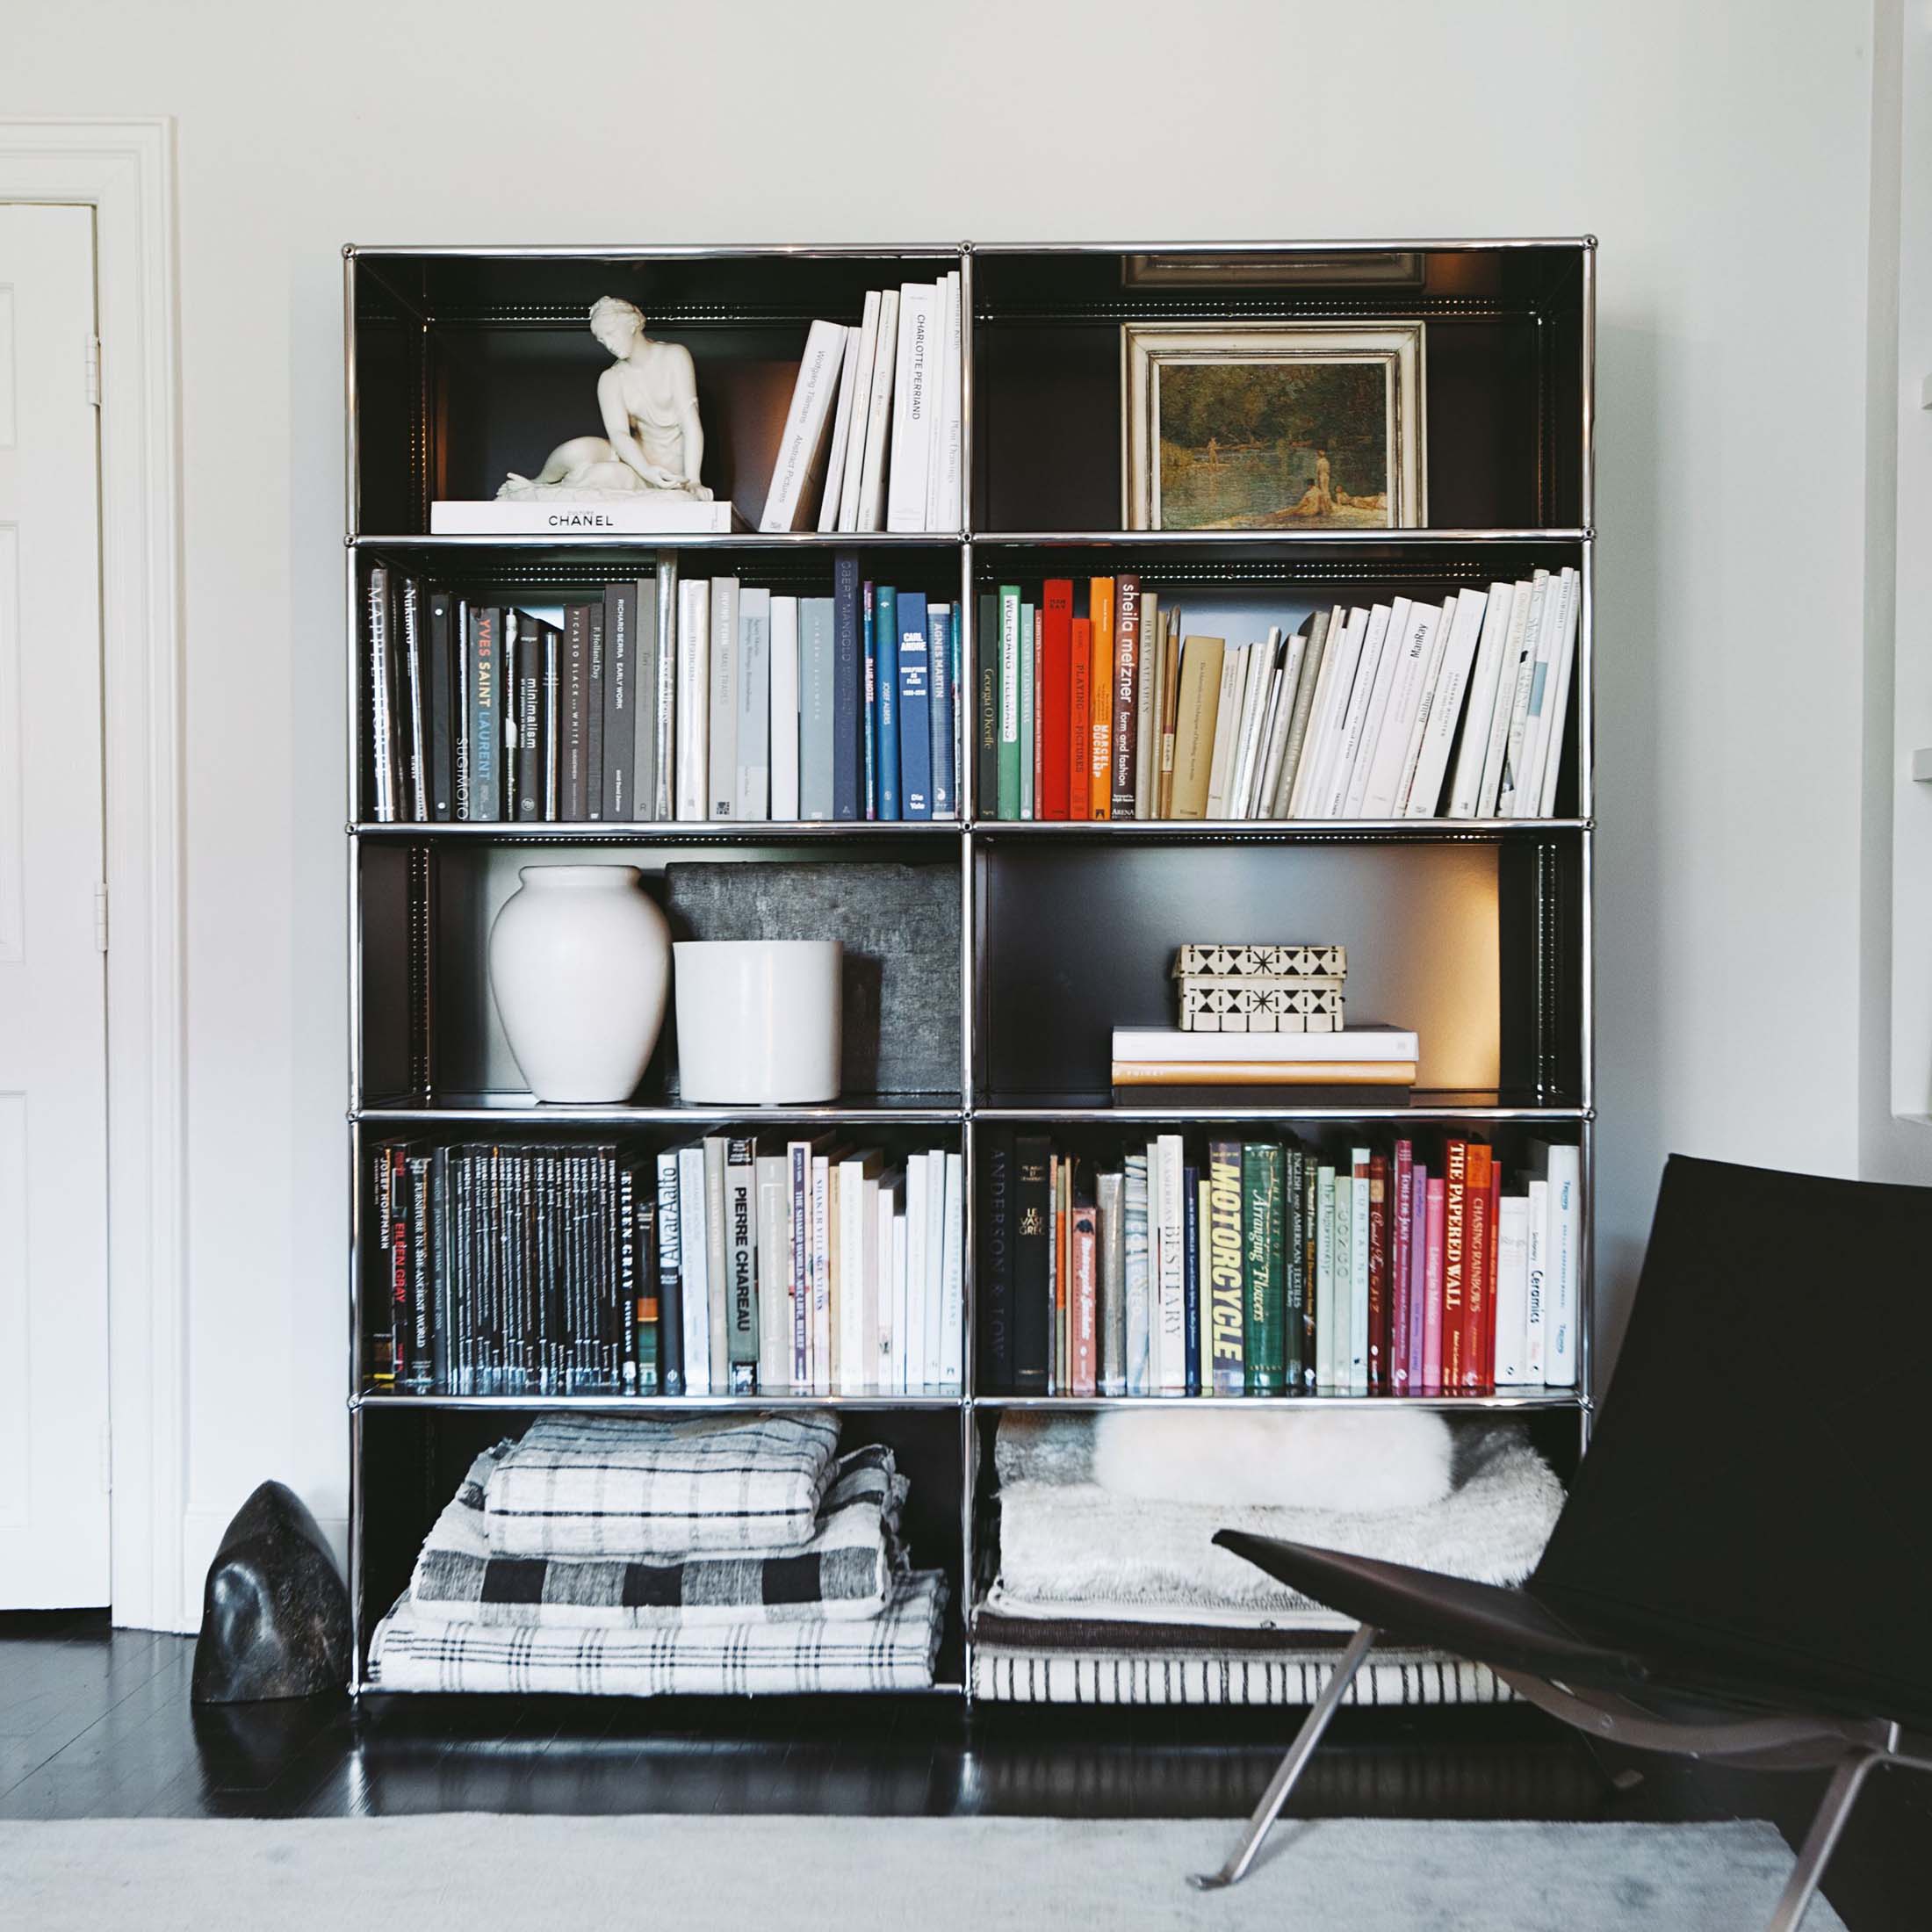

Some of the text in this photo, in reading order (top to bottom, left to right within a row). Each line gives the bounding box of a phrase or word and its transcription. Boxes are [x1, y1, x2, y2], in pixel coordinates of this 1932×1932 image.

[912, 314, 926, 421] CHARLOTTE PERRIAND
[778, 350, 826, 504] Wolfgang Tillmans Abstract Pictures
[548, 515, 614, 527] CHANEL
[840, 561, 852, 600] OBERT
[1121, 583, 1139, 631] sheila
[478, 618, 492, 657] YVES
[592, 634, 601, 663] Holland
[840, 603, 852, 661] MANGOLD
[934, 623, 944, 698] AGNES MARTIN
[1409, 623, 1430, 659] ManRay
[478, 660, 492, 708] SAINT
[591, 664, 601, 680] Day
[1005, 599, 1015, 739] WOLFGANG TILLMANS
[1120, 638, 1137, 703] metzner
[1142, 619, 1153, 714] HARRY CALLAHAN
[526, 677, 538, 749] minimalism
[882, 681, 891, 725] JOSEF ALBERS
[982, 668, 995, 750] Georgia O'Keeffe
[1074, 663, 1085, 773] PLAYING PICTURES
[1120, 711, 1132, 732] form
[1417, 690, 1433, 724] Balthus
[478, 710, 492, 780] LAURENT
[1092, 724, 1102, 778] DUCHAMP
[1100, 724, 1109, 768] MARCEL
[1118, 753, 1130, 787] fashion
[1119, 734, 1131, 752] and
[456, 737, 469, 820] SUGIMOTO
[380, 1157, 390, 1249] JOSEF HOFFMANN
[795, 1190, 805, 1208] THE
[1294, 1151, 1302, 1190] ENGLISH
[621, 1171, 633, 1238] EILEEN
[659, 1167, 679, 1262] AlvarAalto
[795, 1209, 805, 1242] SHAKER
[1307, 1211, 1316, 1238] Fashion
[1357, 1184, 1366, 1285] CURTAINS
[1370, 1212, 1385, 1247] Oriental
[1445, 1143, 1466, 1310] THE PAPERED WALL
[394, 1222, 407, 1303] EILEEN GRAY
[415, 1181, 426, 1348] FURNITURE IN THE ANCIENT WORLD
[621, 1244, 633, 1289] GRAY
[734, 1186, 750, 1332] PIERRE CHAREAU
[815, 1179, 824, 1311] SHAKER VILLAGE VIEWS
[990, 1149, 1006, 1360] ANDERSON & LOW
[1130, 1222, 1143, 1316] COLLECTED
[1211, 1161, 1243, 1362] MOTORCYCLE
[1248, 1188, 1270, 1323] Arranging Flowers
[1272, 1243, 1280, 1258] OF
[1294, 1211, 1302, 1264] AMERICAN
[1370, 1247, 1385, 1272] Rugs
[1469, 1197, 1484, 1313] CHASING RAINBOWS
[1529, 1231, 1539, 1262] Dictionary
[1078, 1236, 1093, 1341] Motorcycle Jackets
[1164, 1225, 1181, 1339] BESTIARY
[1426, 1245, 1440, 1325] Living in Mexico
[1530, 1270, 1546, 1323] Ceramics
